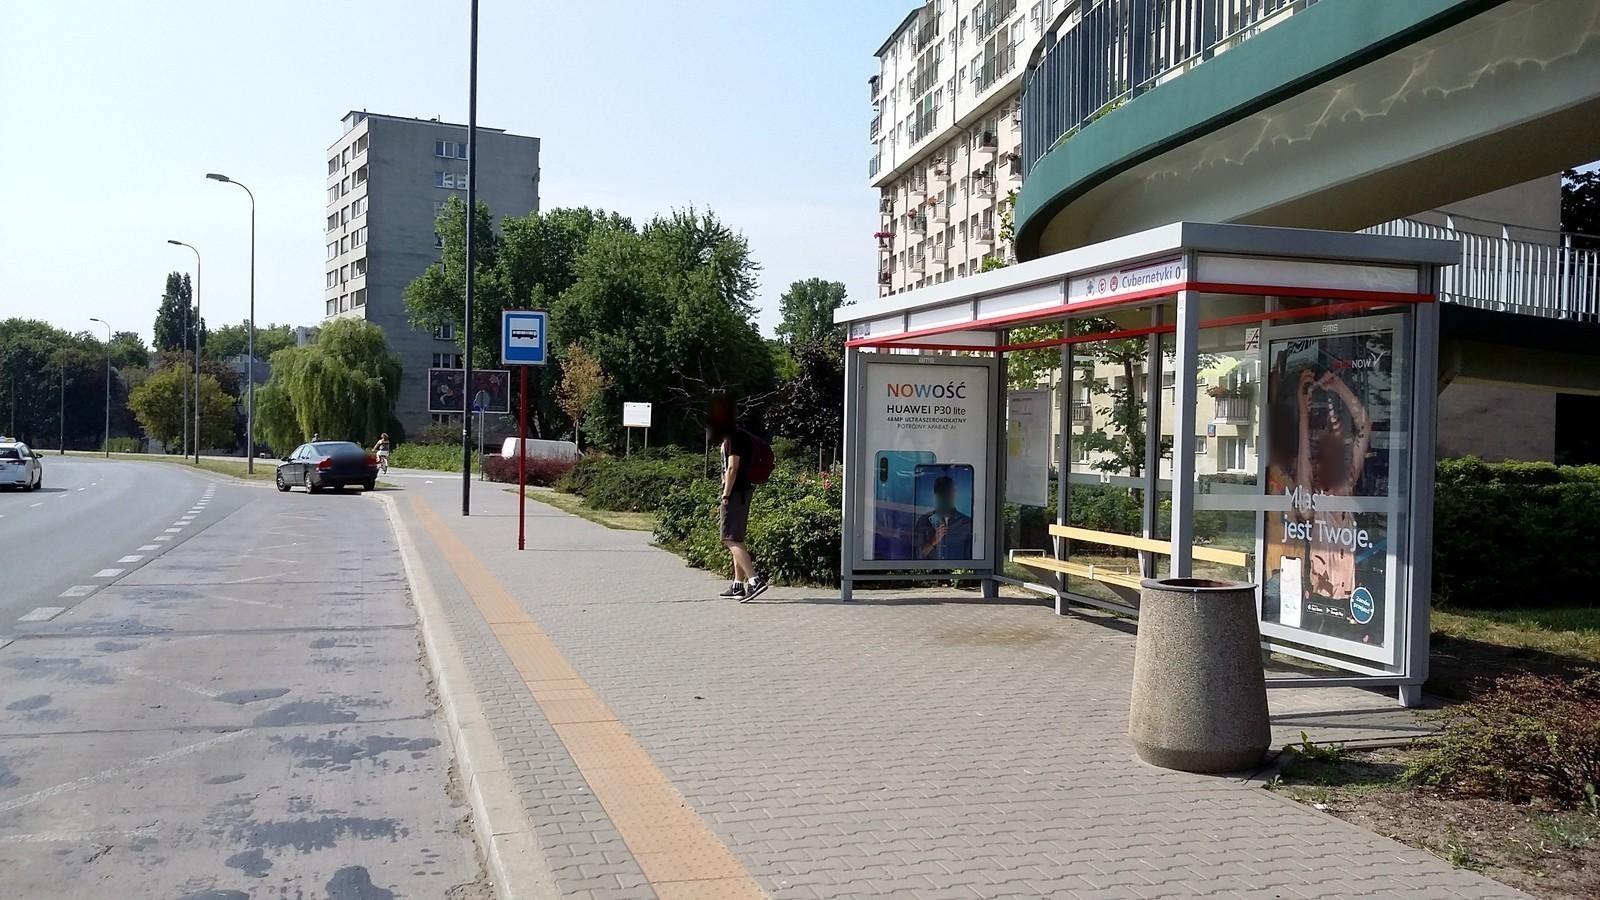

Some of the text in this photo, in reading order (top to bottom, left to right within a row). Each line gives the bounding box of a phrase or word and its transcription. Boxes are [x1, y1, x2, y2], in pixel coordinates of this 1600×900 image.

[1122, 266, 1172, 289] Cybernetyki
[887, 381, 966, 399] NOWOŚĆ
[887, 404, 966, 415] HUAWEI P30 lite
[1285, 485, 1334, 511] Miast
[1281, 514, 1373, 552] jest Twoje.
